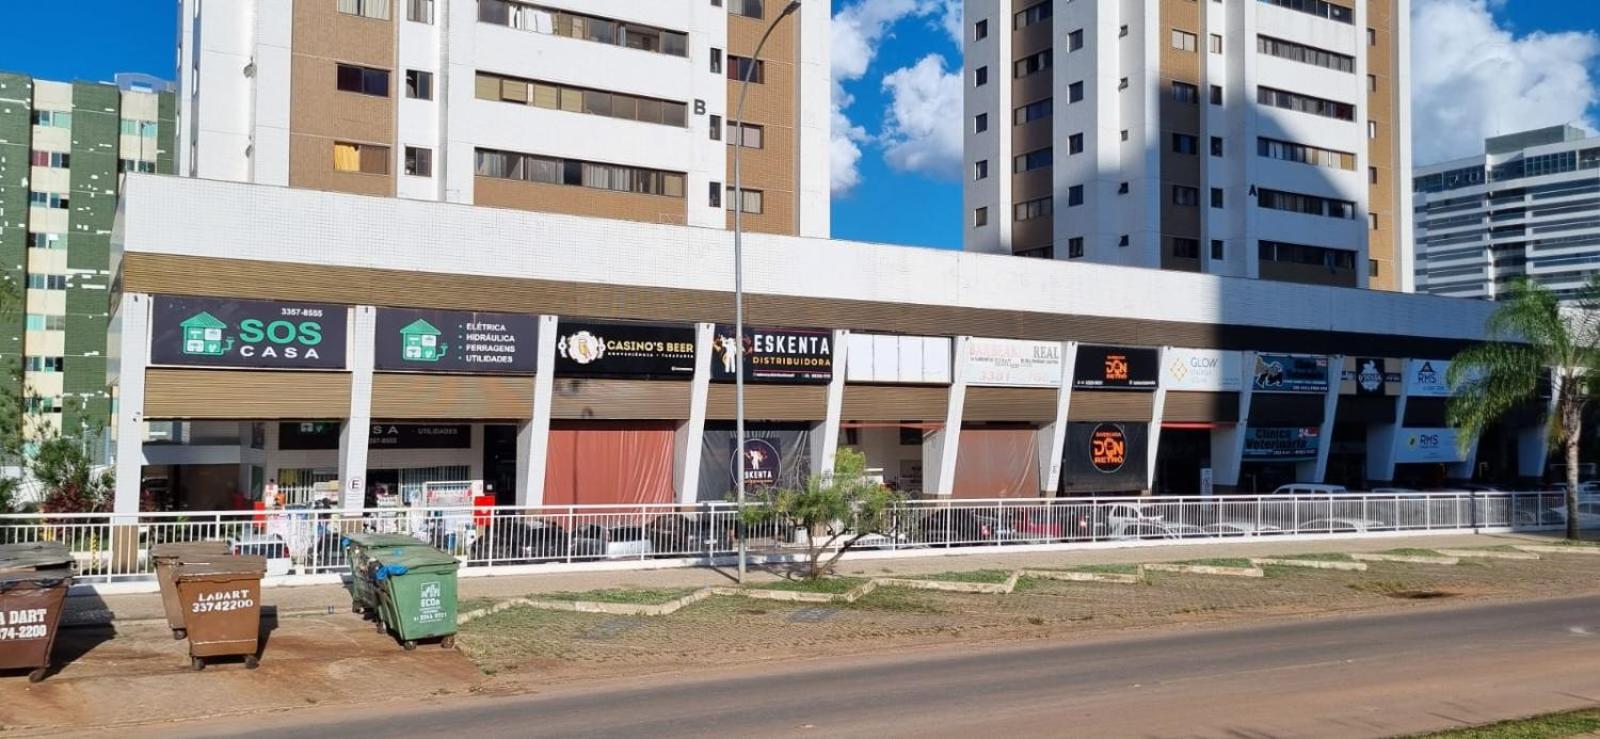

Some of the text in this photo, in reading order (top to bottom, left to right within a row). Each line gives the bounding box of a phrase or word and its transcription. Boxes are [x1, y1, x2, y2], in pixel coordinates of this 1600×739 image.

[694, 99, 706, 115] B
[1248, 184, 1257, 197] A
[239, 318, 322, 346] SOS
[466, 321, 506, 331] ELÉTRICA
[466, 332, 515, 342] HIDRÁULICA
[466, 345, 515, 353] FERRAGENS
[607, 340, 694, 353] CASINO'S BEER
[753, 334, 830, 355] ESKENTA
[240, 346, 320, 359] CASA
[466, 354, 513, 363] UTILIDADES
[1033, 345, 1059, 359] REAL
[753, 357, 831, 366] DISTRIBUIDORA
[1190, 357, 1218, 368] GLOW
[1093, 437, 1124, 456] DON
[1420, 434, 1439, 446] RMS
[744, 470, 773, 479] SKENTA
[351, 480, 360, 489] E
[199, 589, 250, 602] LADART
[192, 598, 254, 613] 33742200
[9, 608, 47, 624] DART
[0, 624, 47, 640] 74-2200
